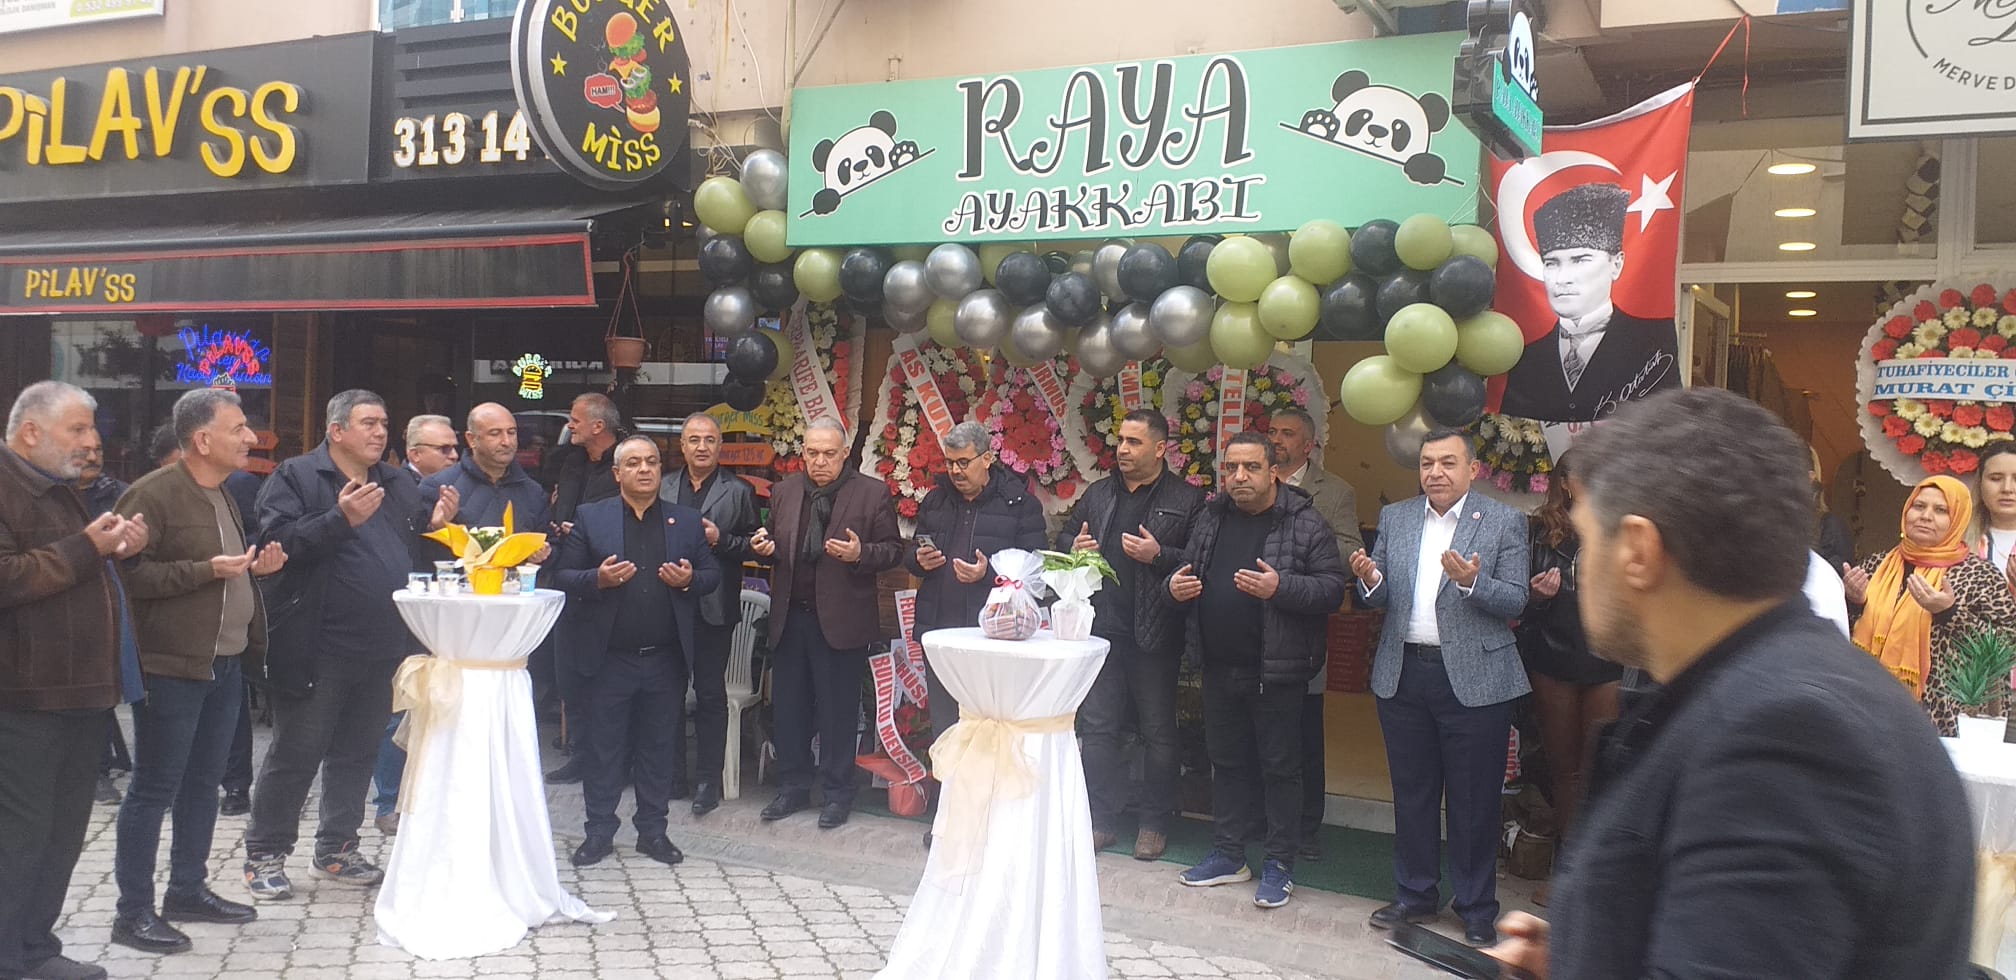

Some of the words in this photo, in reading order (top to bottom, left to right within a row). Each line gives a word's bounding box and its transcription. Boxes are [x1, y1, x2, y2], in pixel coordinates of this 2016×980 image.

[1933, 57, 1998, 91] MERVE
[393, 112, 466, 168] 313
[957, 57, 1252, 179] RAYA
[944, 177, 1264, 232] AYAKKABI
[1874, 382, 1975, 396] MURAT
[1877, 360, 2009, 379] TUHAFİYECİLER
[871, 657, 894, 723] BULUTLU
